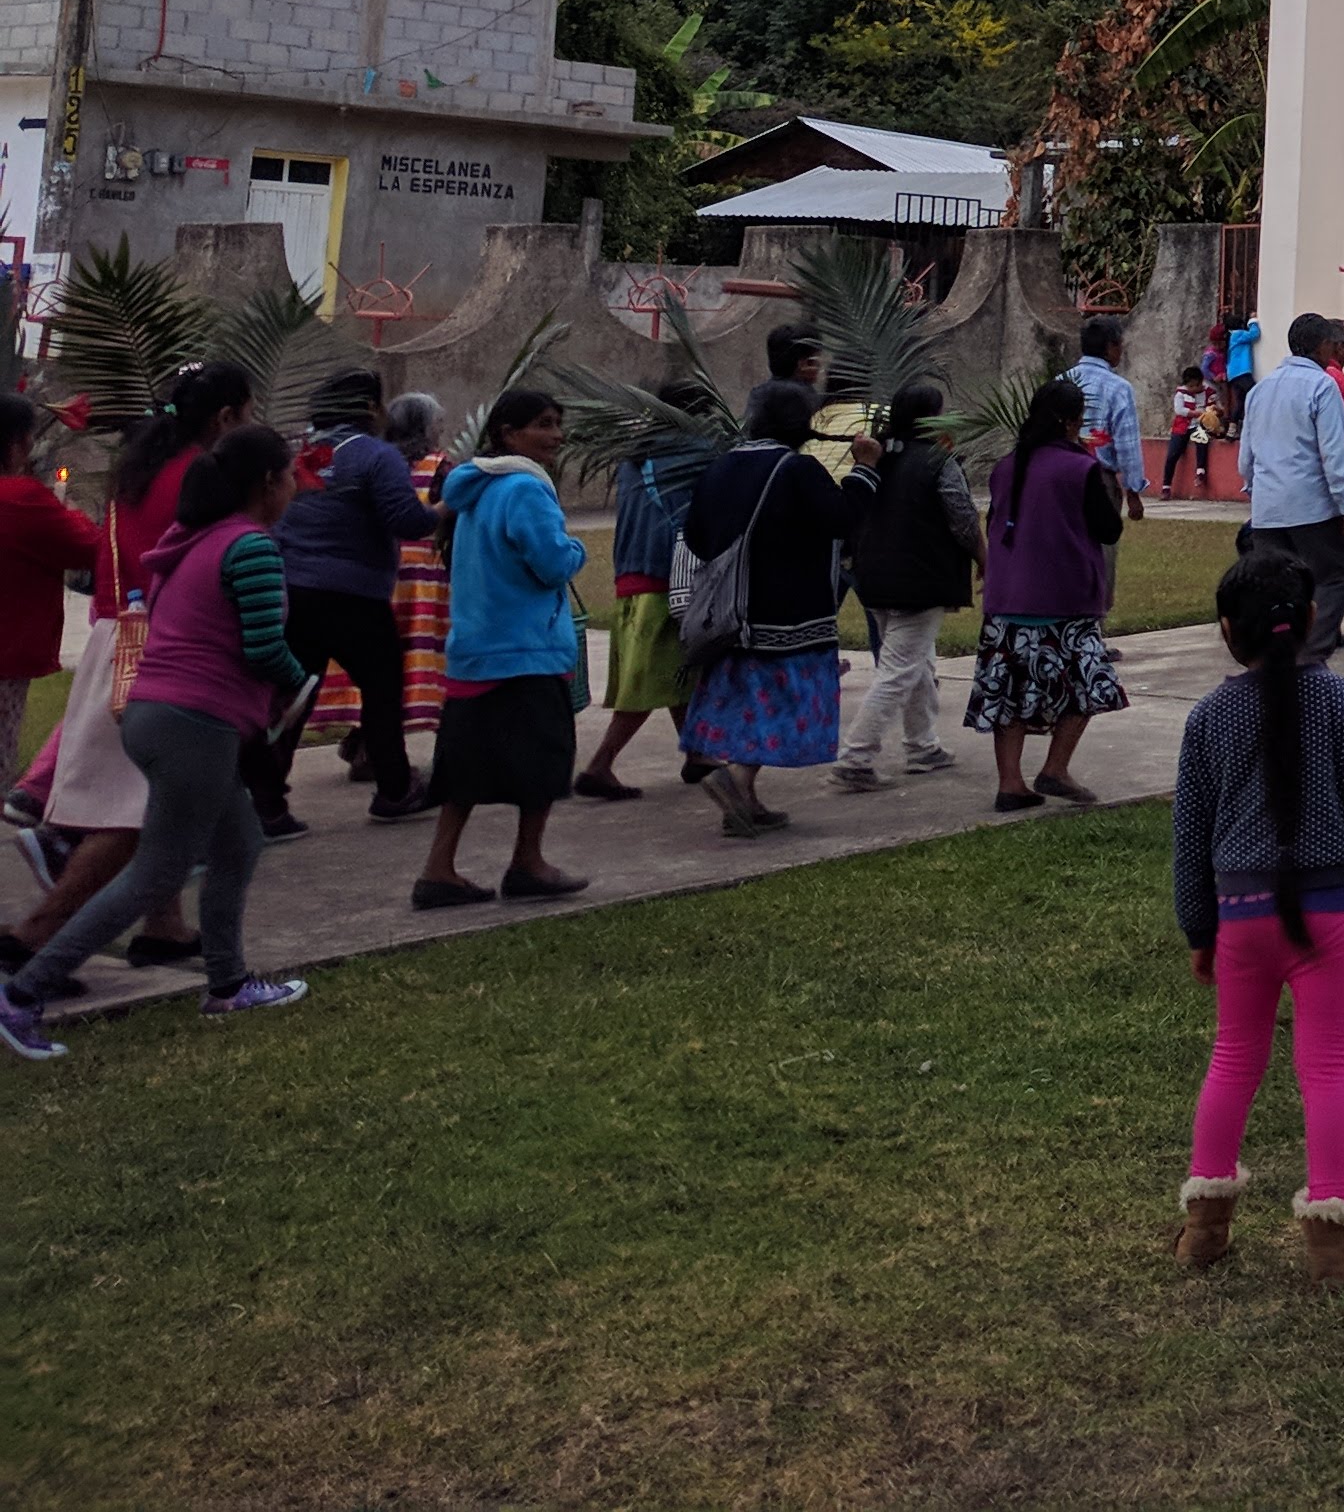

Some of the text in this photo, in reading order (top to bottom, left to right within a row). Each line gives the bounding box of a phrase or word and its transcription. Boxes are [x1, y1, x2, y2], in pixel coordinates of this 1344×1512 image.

[381, 155, 492, 179] MISCELANEA
[379, 175, 514, 200] LA ESPERANZA
